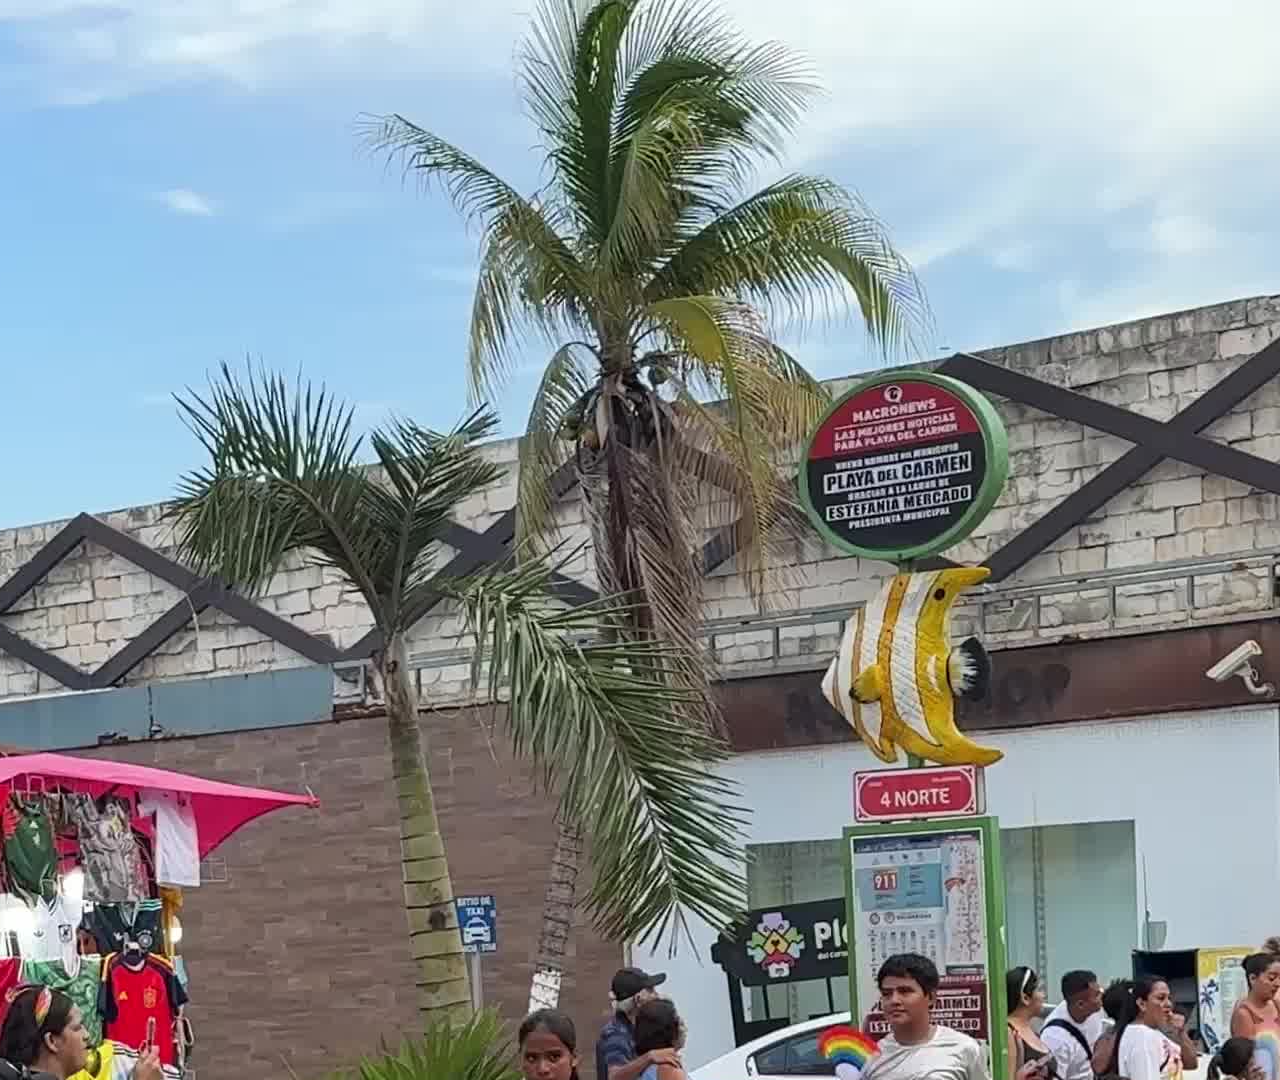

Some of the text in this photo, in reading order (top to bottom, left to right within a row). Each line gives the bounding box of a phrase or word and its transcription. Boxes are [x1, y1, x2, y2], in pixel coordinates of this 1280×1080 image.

[852, 398, 937, 423] MACRONEWS
[827, 454, 969, 491] PLAYA DEL CARMEN
[903, 487, 969, 509] MERCADO
[880, 788, 951, 807] 4 NORTE
[875, 874, 896, 888] 911
